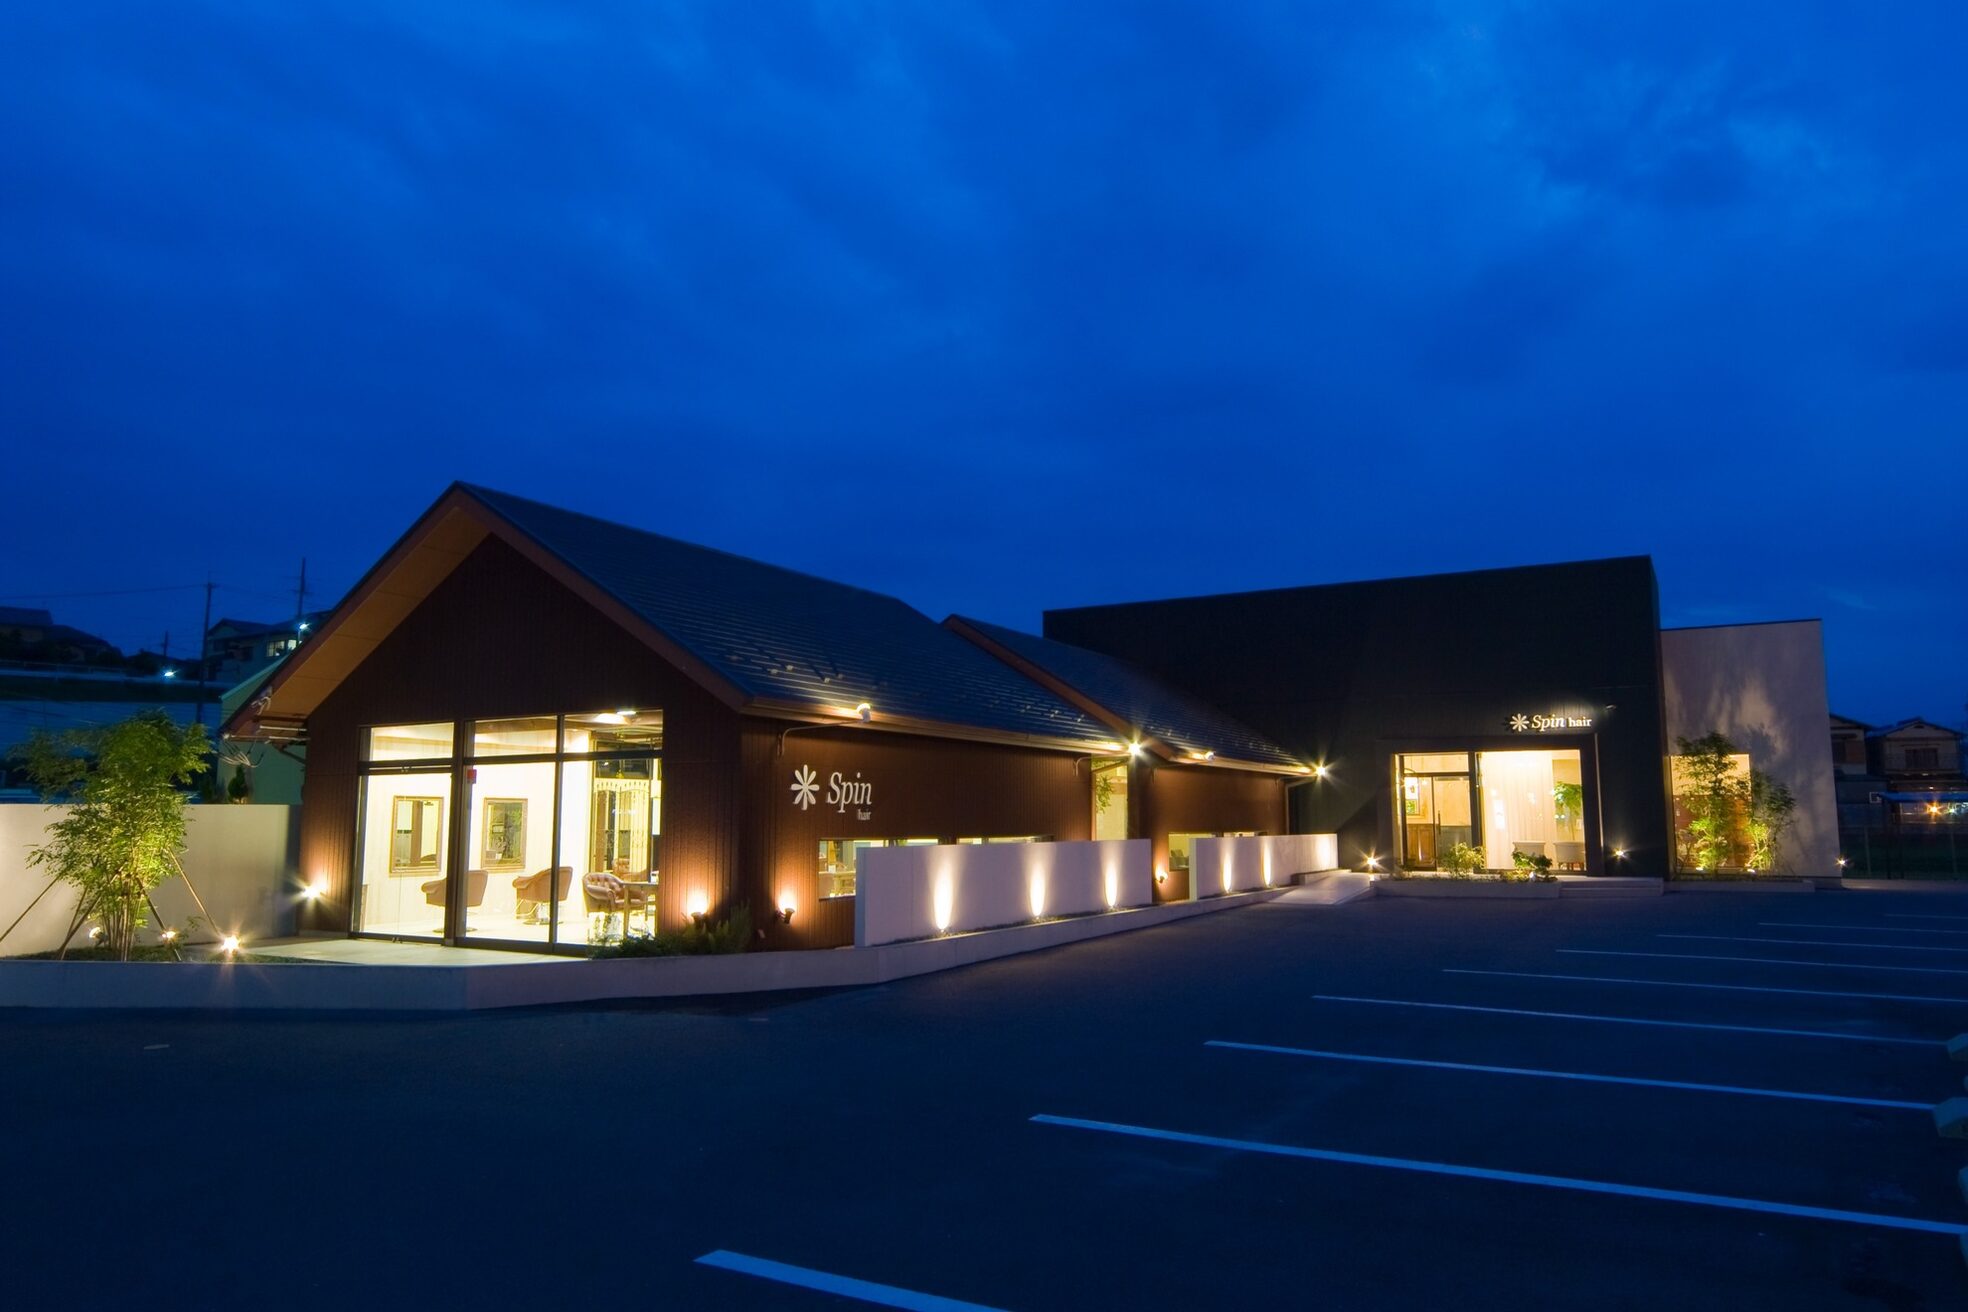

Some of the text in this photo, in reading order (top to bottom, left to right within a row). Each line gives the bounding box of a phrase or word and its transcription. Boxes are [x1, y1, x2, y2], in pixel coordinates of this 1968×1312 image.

[1531, 714, 1592, 731] Spin hair
[827, 771, 872, 813] Spin
[857, 809, 871, 820] hair
